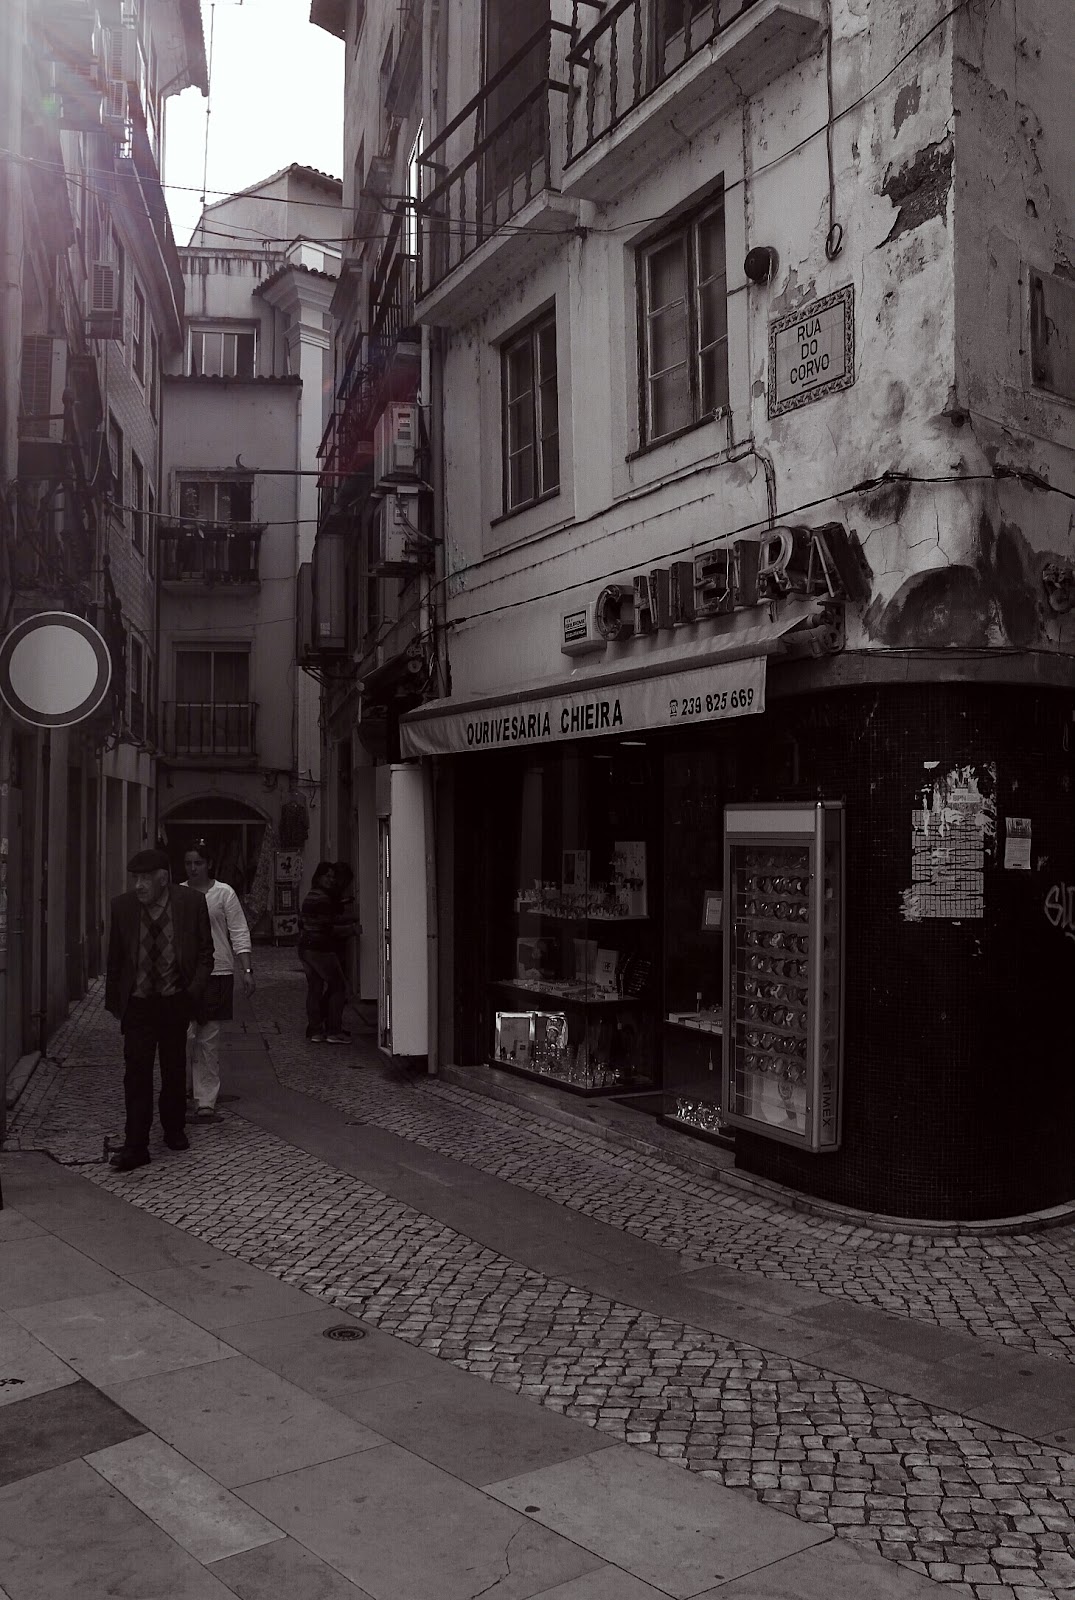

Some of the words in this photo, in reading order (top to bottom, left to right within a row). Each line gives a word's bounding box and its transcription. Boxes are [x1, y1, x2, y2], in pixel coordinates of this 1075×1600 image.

[797, 318, 821, 342] RUA
[801, 339, 818, 360] DO
[790, 354, 830, 384] CORVO
[595, 522, 856, 641] CHIEIRA
[681, 696, 702, 716] 239
[706, 692, 728, 712] 825
[730, 688, 754, 708] 669
[467, 711, 551, 746] OURIVESARIA
[561, 699, 623, 734] CHIEIRA
[822, 1081, 832, 1127] TIMEX
